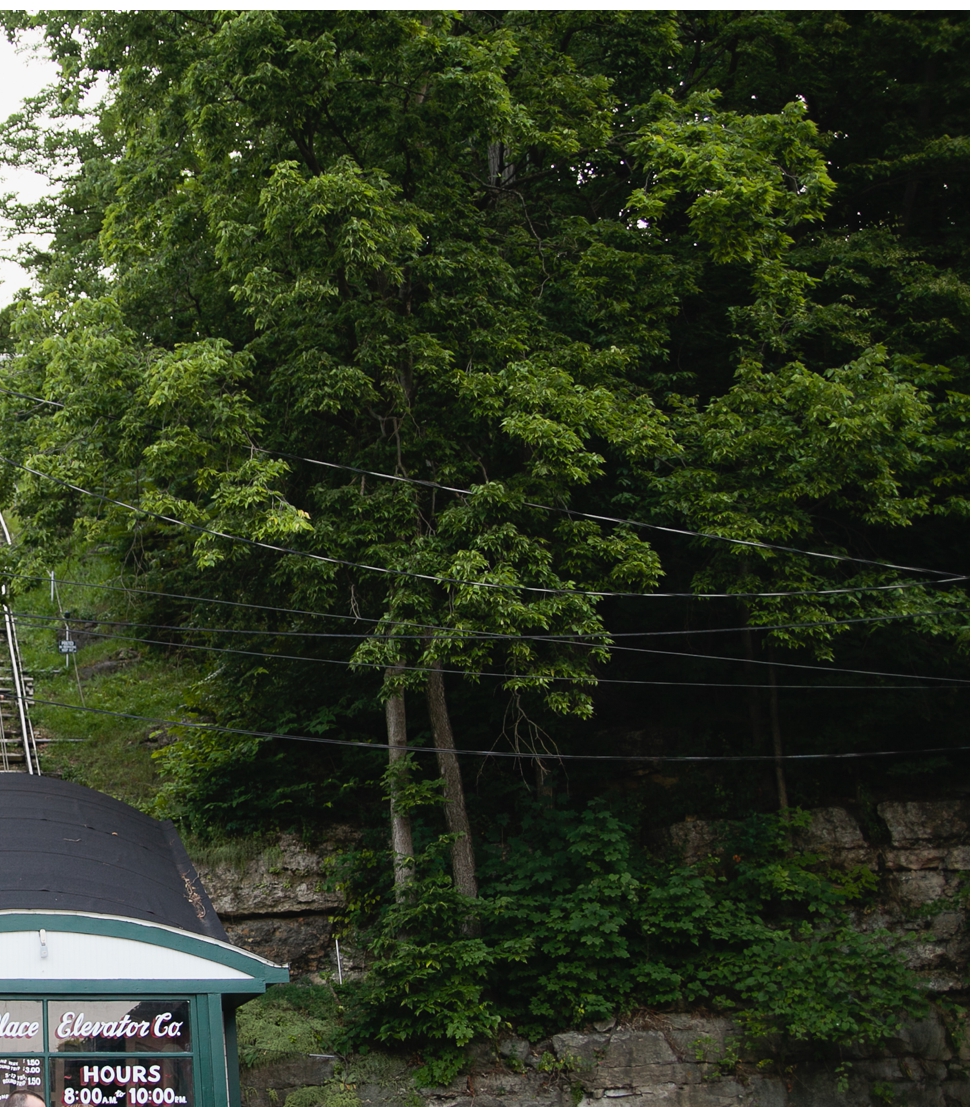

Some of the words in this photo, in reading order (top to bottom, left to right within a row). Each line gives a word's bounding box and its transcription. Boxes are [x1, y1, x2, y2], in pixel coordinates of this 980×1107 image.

[57, 1011, 150, 1038] Elevator
[153, 1012, 183, 1037] Co.
[83, 1065, 161, 1083] HOURS
[115, 1090, 126, 1098] to
